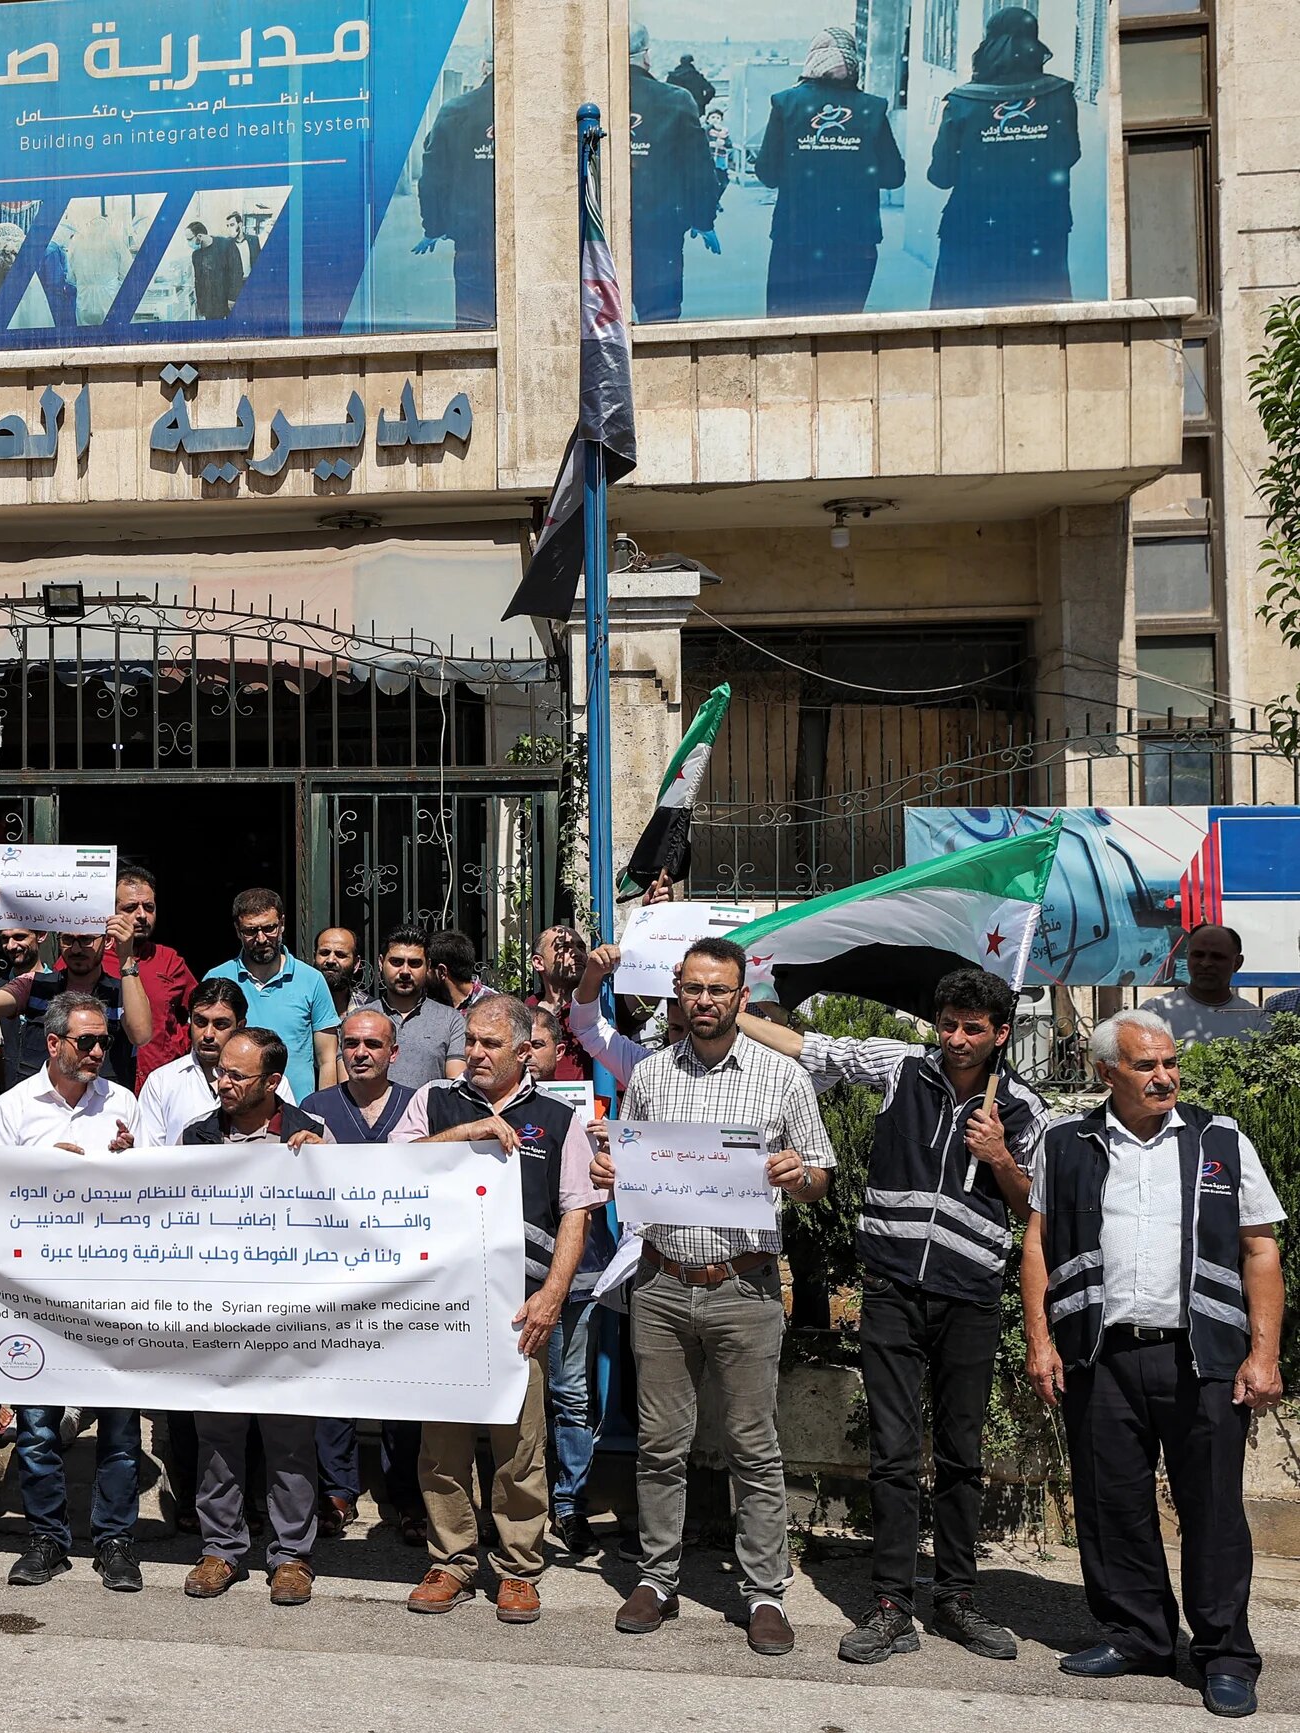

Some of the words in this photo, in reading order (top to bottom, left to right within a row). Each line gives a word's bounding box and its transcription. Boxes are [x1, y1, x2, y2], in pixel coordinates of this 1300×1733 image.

[84, 19, 371, 91] مديرية
[212, 91, 299, 114] نظام
[304, 90, 370, 105] بناء
[15, 105, 118, 126] متكامل
[19, 134, 95, 151] Building
[102, 131, 124, 146] an
[131, 123, 229, 146] integrated
[237, 120, 296, 138] health
[304, 115, 371, 137] system
[151, 362, 472, 485] مديرية
[15, 889, 41, 898] منطقتنا
[70, 890, 88, 902] يعني
[25, 914, 44, 923] الدواء
[47, 915, 57, 924] من
[649, 933, 686, 942] المساعدات
[639, 960, 656, 971] هجرة
[651, 1150, 674, 1161] اللقاح
[677, 1150, 705, 1162] برنامج
[708, 1152, 730, 1163] إيقاف
[9, 1185, 48, 1202] الدواء
[53, 1187, 76, 1203] من
[81, 1186, 132, 1203] سيجعل
[137, 1185, 186, 1204] للنظام
[191, 1185, 254, 1203] الإنسانية
[260, 1185, 335, 1201] المساعدات
[341, 1186, 376, 1201] ملف
[382, 1185, 429, 1205] تسليم
[618, 1181, 648, 1191] المنطقة
[651, 1182, 662, 1195] في
[721, 1186, 734, 1198] إلى
[10, 1211, 84, 1229] المدنيين
[94, 1211, 151, 1229] وحصار
[161, 1211, 200, 1229] لقتل
[210, 1212, 276, 1231] إضافيا
[360, 1213, 431, 1231] والغذاء
[40, 1243, 73, 1263] عبرة
[78, 1244, 128, 1263] ومضايا
[132, 1243, 193, 1263] الشرقية
[199, 1246, 239, 1265] وحلب
[243, 1246, 297, 1265] الغوطة
[302, 1247, 339, 1266] حصار
[344, 1247, 370, 1272] في
[375, 1247, 401, 1265] ولنا
[22, 1293, 42, 1305] the
[45, 1296, 126, 1311] humanitarian
[130, 1299, 150, 1311] aid
[154, 1299, 173, 1311] file
[177, 1300, 189, 1312] to
[193, 1300, 213, 1312] the
[221, 1300, 262, 1315] Syrian
[267, 1301, 311, 1316] regime
[315, 1300, 337, 1313] will
[340, 1300, 377, 1312] make
[381, 1299, 441, 1312] medicine
[445, 1299, 470, 1312] and
[13, 1309, 29, 1320] an
[33, 1311, 91, 1327] additional
[94, 1319, 143, 1333] weapon
[147, 1320, 160, 1332] to
[164, 1320, 181, 1332] kill
[185, 1320, 209, 1333] and
[213, 1320, 271, 1333] blockade
[275, 1320, 331, 1333] civilians,
[335, 1319, 351, 1330] as
[355, 1318, 364, 1330] it
[367, 1318, 379, 1331] is
[383, 1318, 404, 1331] the
[408, 1320, 440, 1332] case
[444, 1320, 471, 1333] with
[63, 1330, 83, 1341] the
[87, 1333, 119, 1346] siege
[122, 1335, 135, 1347] of
[138, 1337, 188, 1350] Ghouta,
[192, 1338, 241, 1350] Eastern
[243, 1338, 289, 1352] Aleppo
[292, 1338, 317, 1350] and
[321, 1338, 385, 1352] Madhaya.
